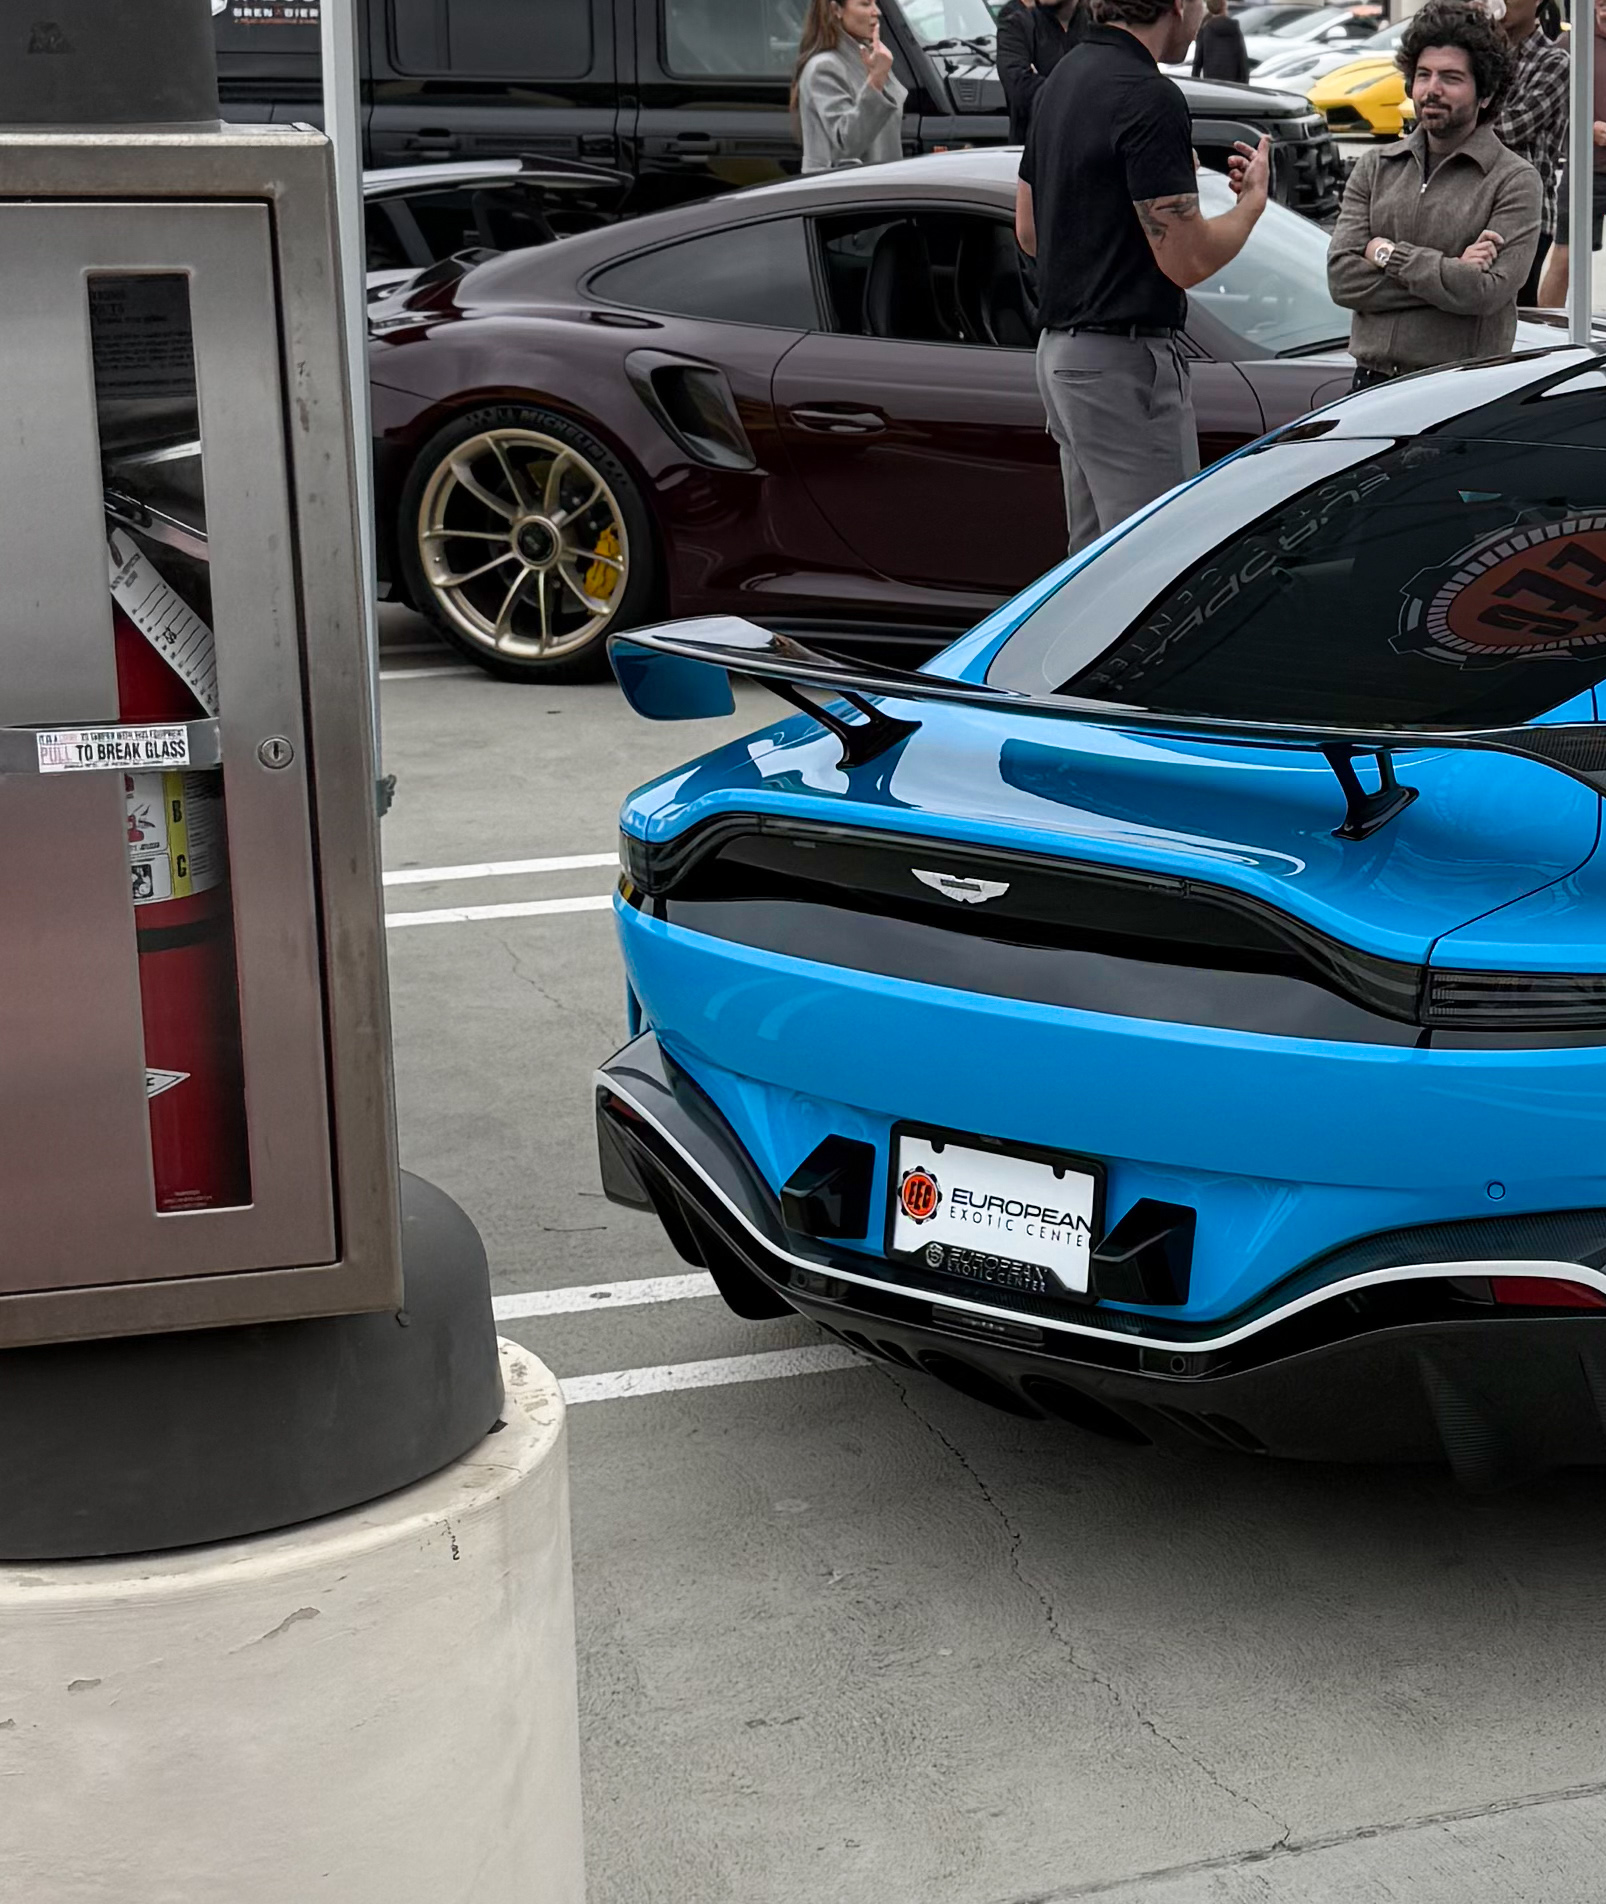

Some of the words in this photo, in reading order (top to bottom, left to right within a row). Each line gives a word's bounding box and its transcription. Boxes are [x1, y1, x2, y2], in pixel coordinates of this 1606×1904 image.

[41, 746, 72, 762] PULL
[76, 744, 94, 762] TO
[97, 742, 141, 761] BREAK
[145, 740, 186, 759] GLASS
[950, 1206, 1015, 1232] EXOTIC
[1026, 1223, 1084, 1248] CENTE
[951, 1187, 1092, 1234] EUROPEAN
